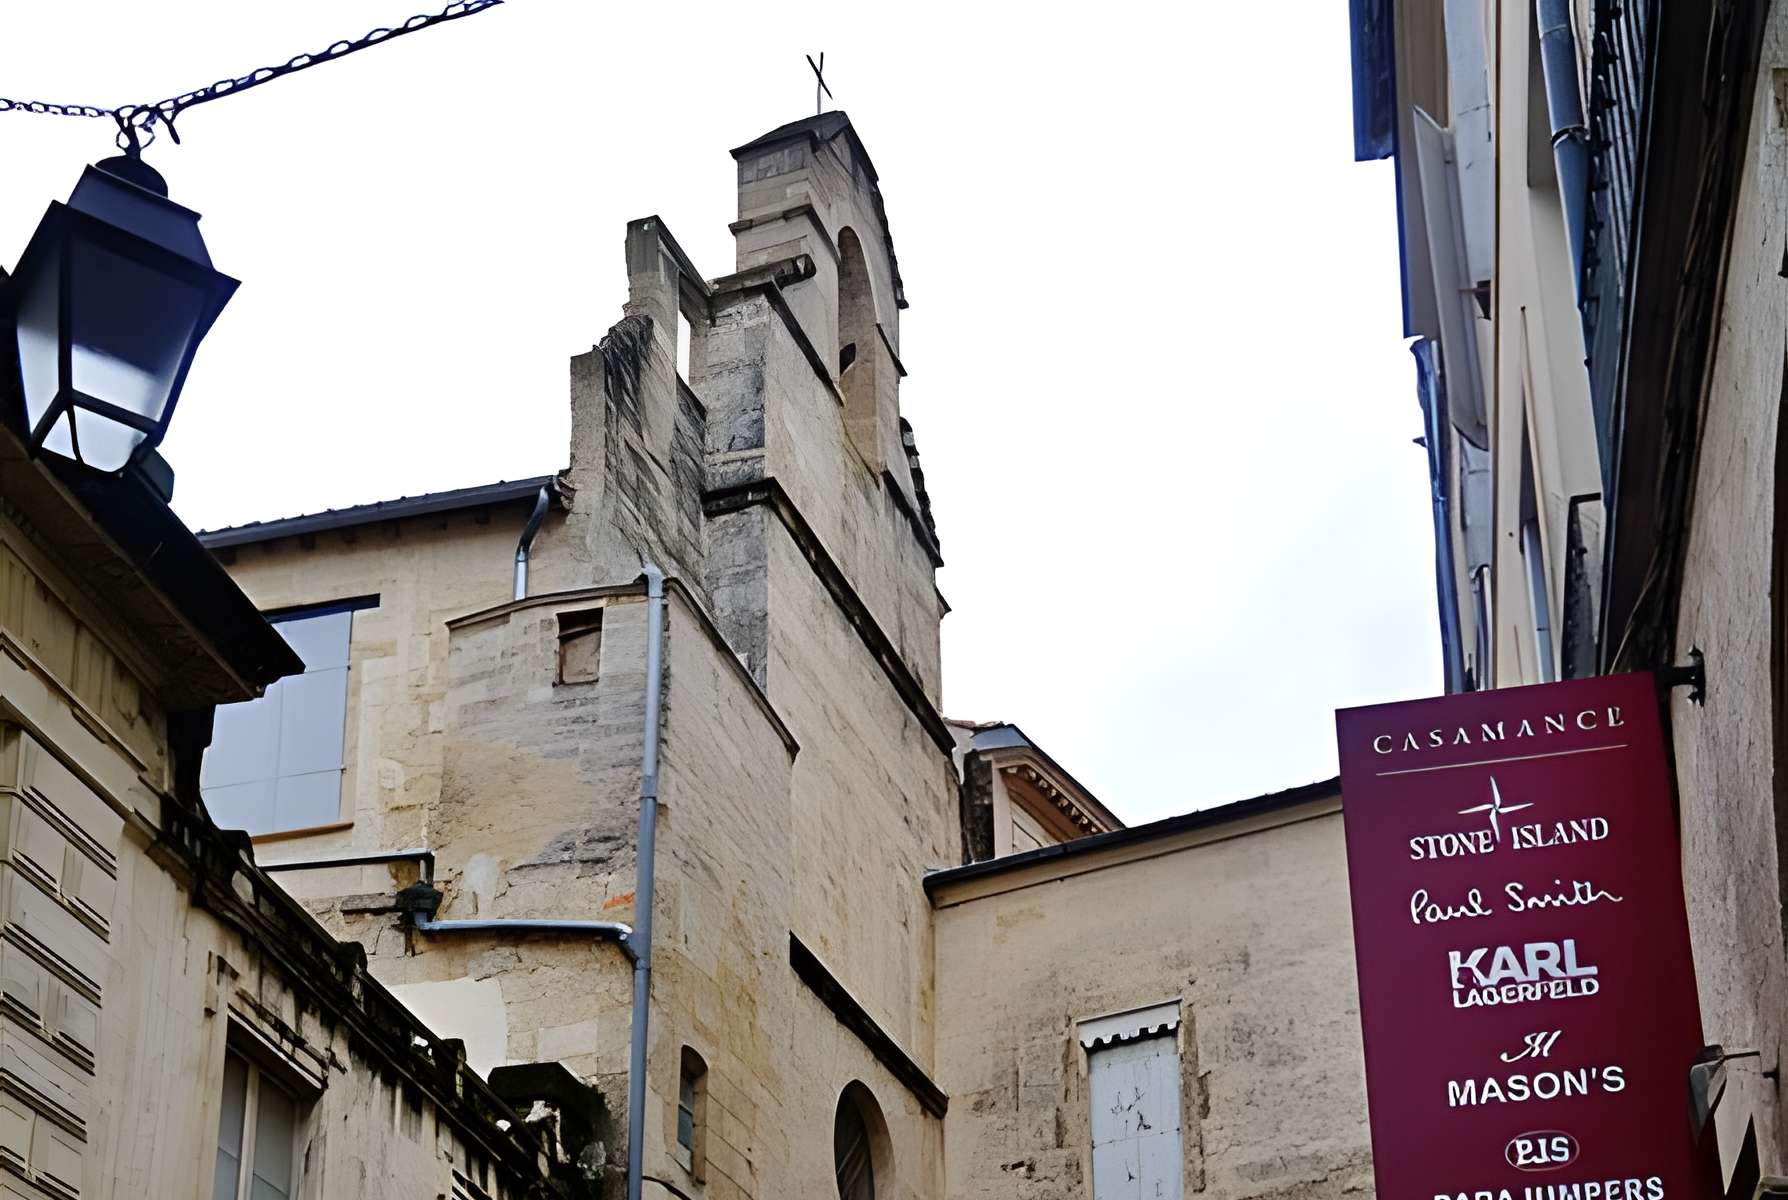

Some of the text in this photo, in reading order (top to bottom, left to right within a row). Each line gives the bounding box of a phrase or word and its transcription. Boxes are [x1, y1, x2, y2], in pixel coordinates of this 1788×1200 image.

[1373, 706, 1626, 755] CASAMANCE
[1410, 816, 1609, 860] STONE ISLAND
[1410, 879, 1623, 925] Paul Smith
[1448, 939, 1598, 988] KARL
[1448, 1065, 1626, 1107] MASON'S
